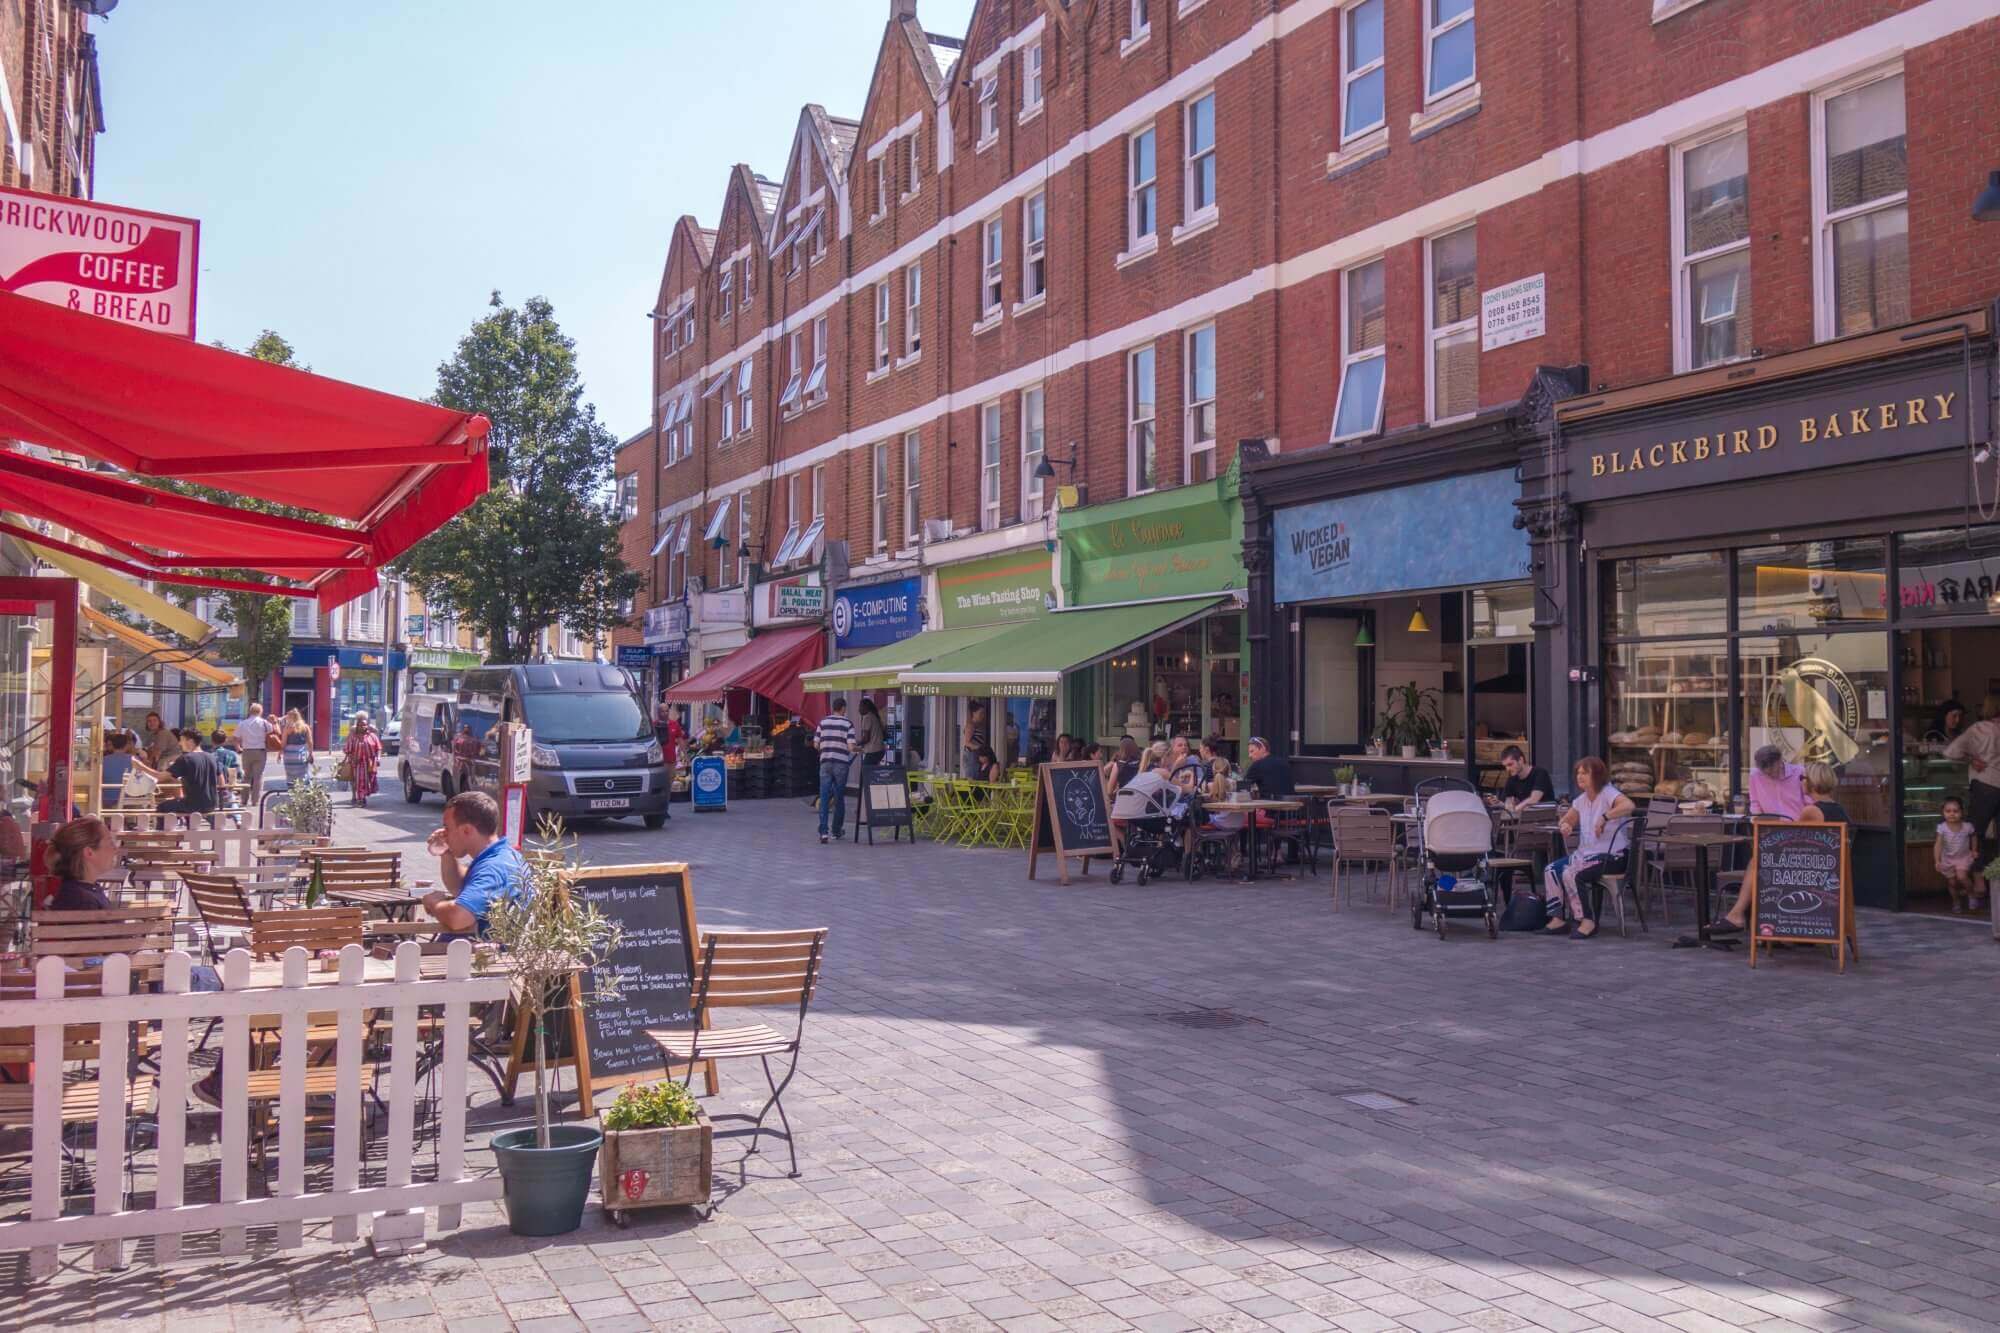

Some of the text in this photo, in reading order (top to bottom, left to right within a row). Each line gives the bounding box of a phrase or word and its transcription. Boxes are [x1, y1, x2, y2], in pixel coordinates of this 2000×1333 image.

[0, 199, 143, 247] RICKWOOD
[78, 253, 165, 290] COFFEE
[1523, 278, 1543, 292] SERVICES
[68, 288, 171, 326] & BREAD
[1590, 391, 1958, 478] BLACKBIRD BAKERY
[1290, 521, 1339, 556] WICKED
[1308, 537, 1351, 570] VEGAN
[781, 588, 822, 597] HALAL MEAT
[792, 598, 822, 607] POULTRY
[957, 586, 1040, 608] The Wine Tasting Shop
[779, 607, 799, 615] OPEN
[853, 595, 908, 618] E-COMPUTING
[1826, 668, 1857, 728] BLACKBIRD
[1761, 852, 1837, 869] BLACKBIRD
[1772, 869, 1829, 886] BAKERY
